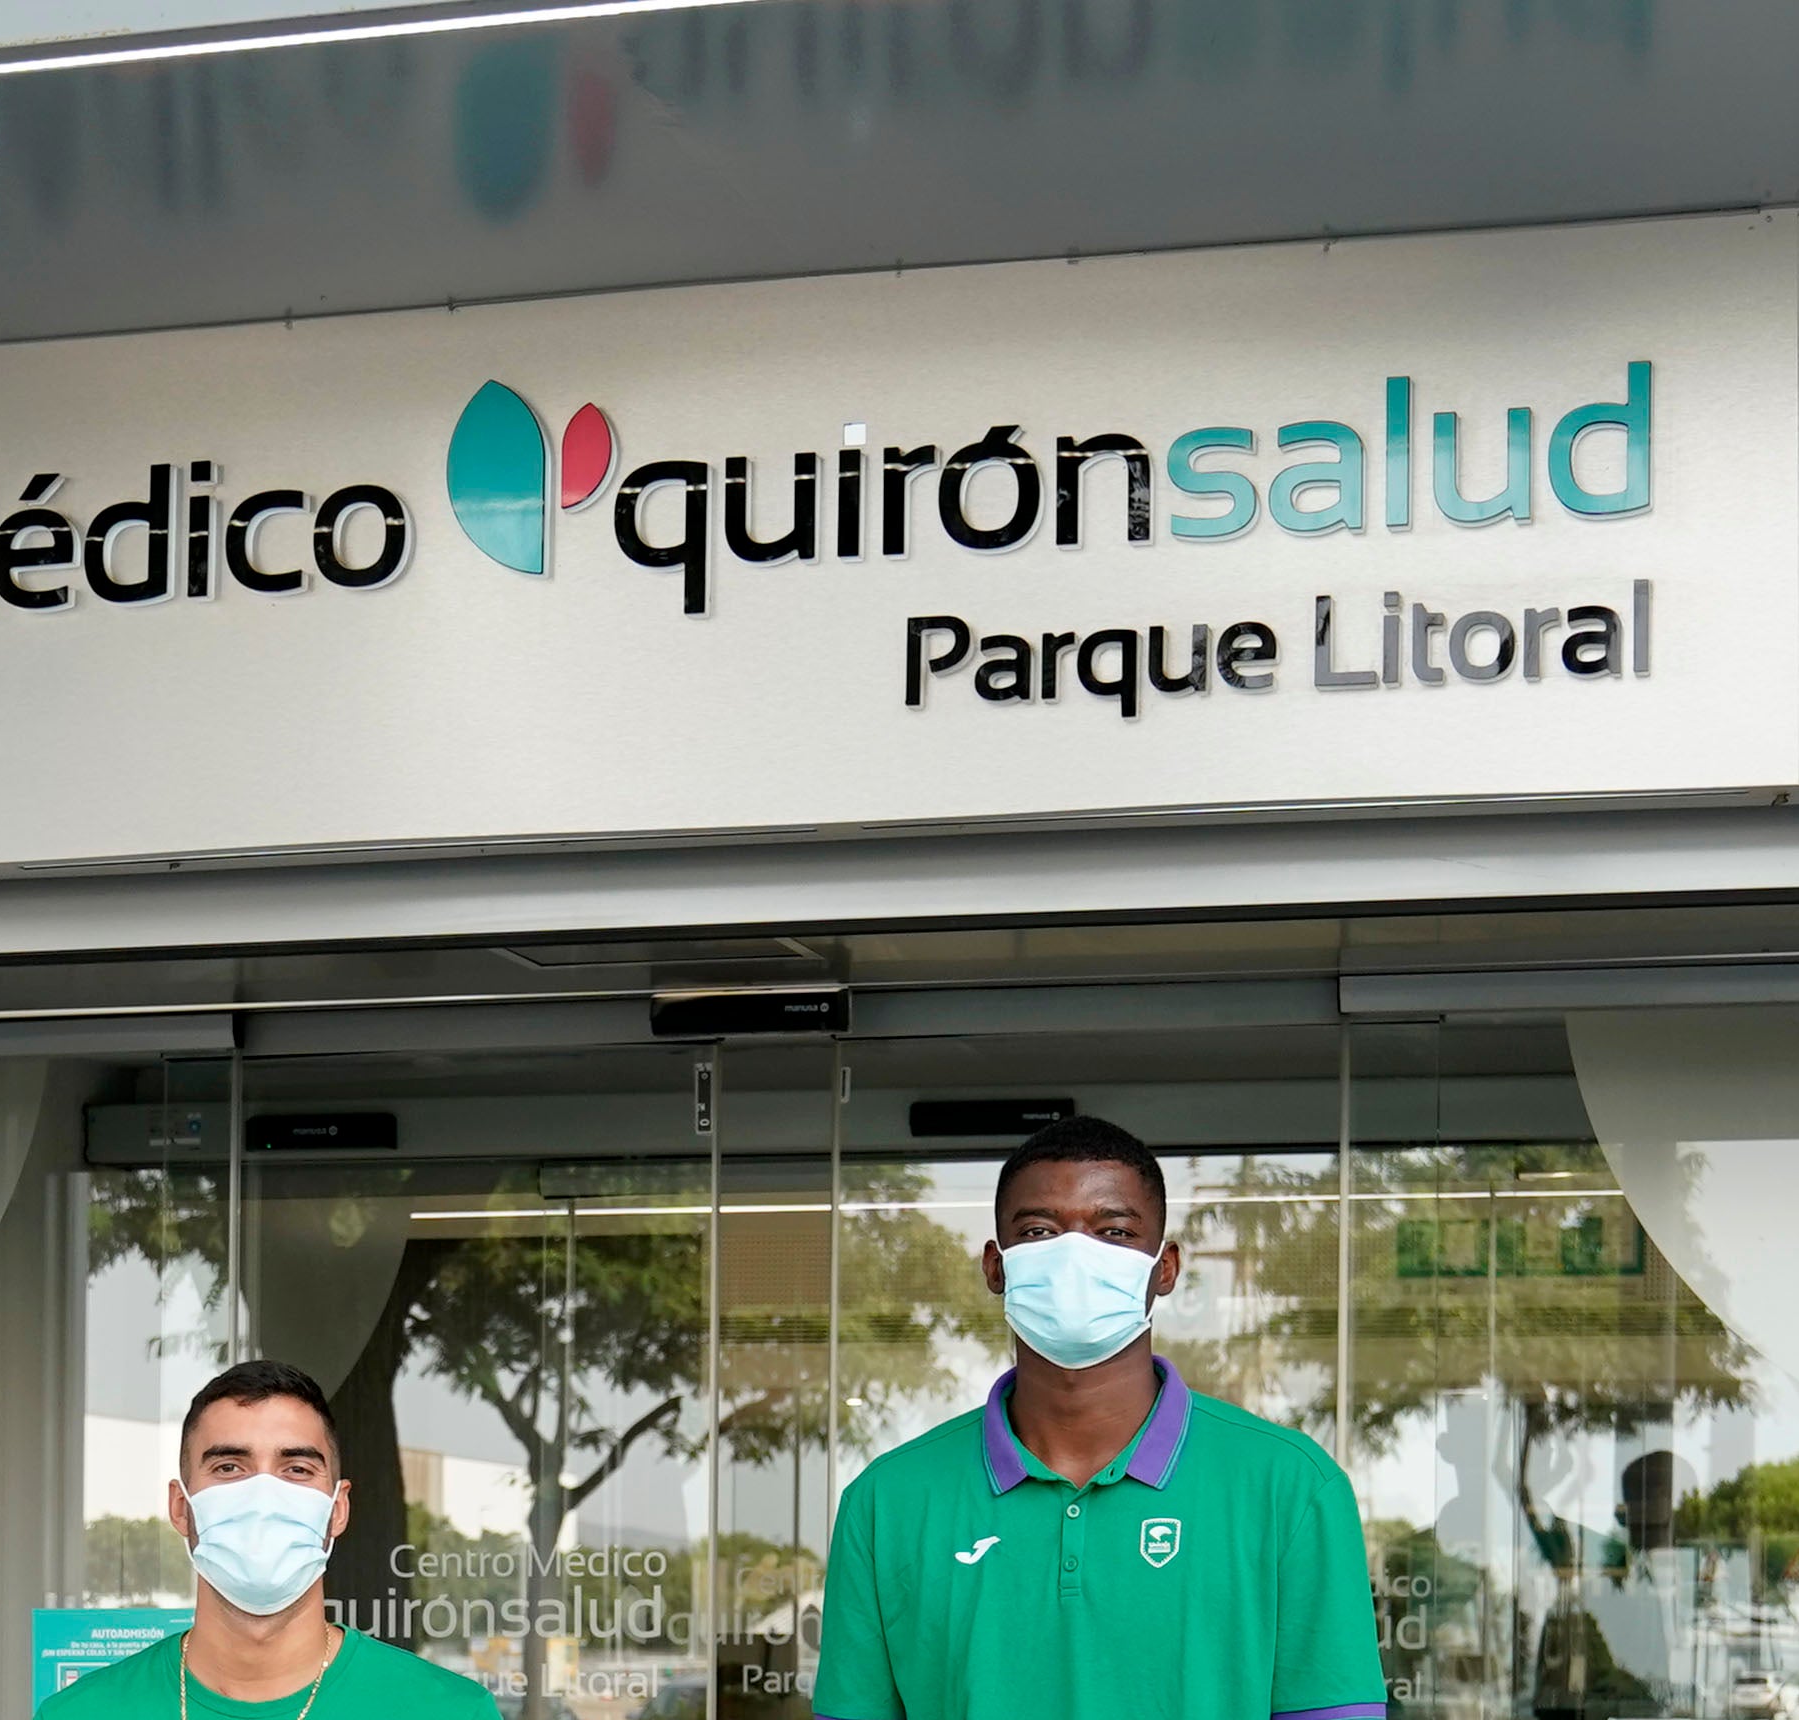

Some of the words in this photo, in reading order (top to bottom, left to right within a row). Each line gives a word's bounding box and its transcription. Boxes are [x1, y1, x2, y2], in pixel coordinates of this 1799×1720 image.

[612, 359, 1655, 617] quirónsalud
[905, 613, 1279, 721] Parque
[1312, 577, 1652, 693] Litoral
[390, 1544, 514, 1579] Centro
[529, 1544, 667, 1578] Médico
[541, 1663, 658, 1697] Litoral
